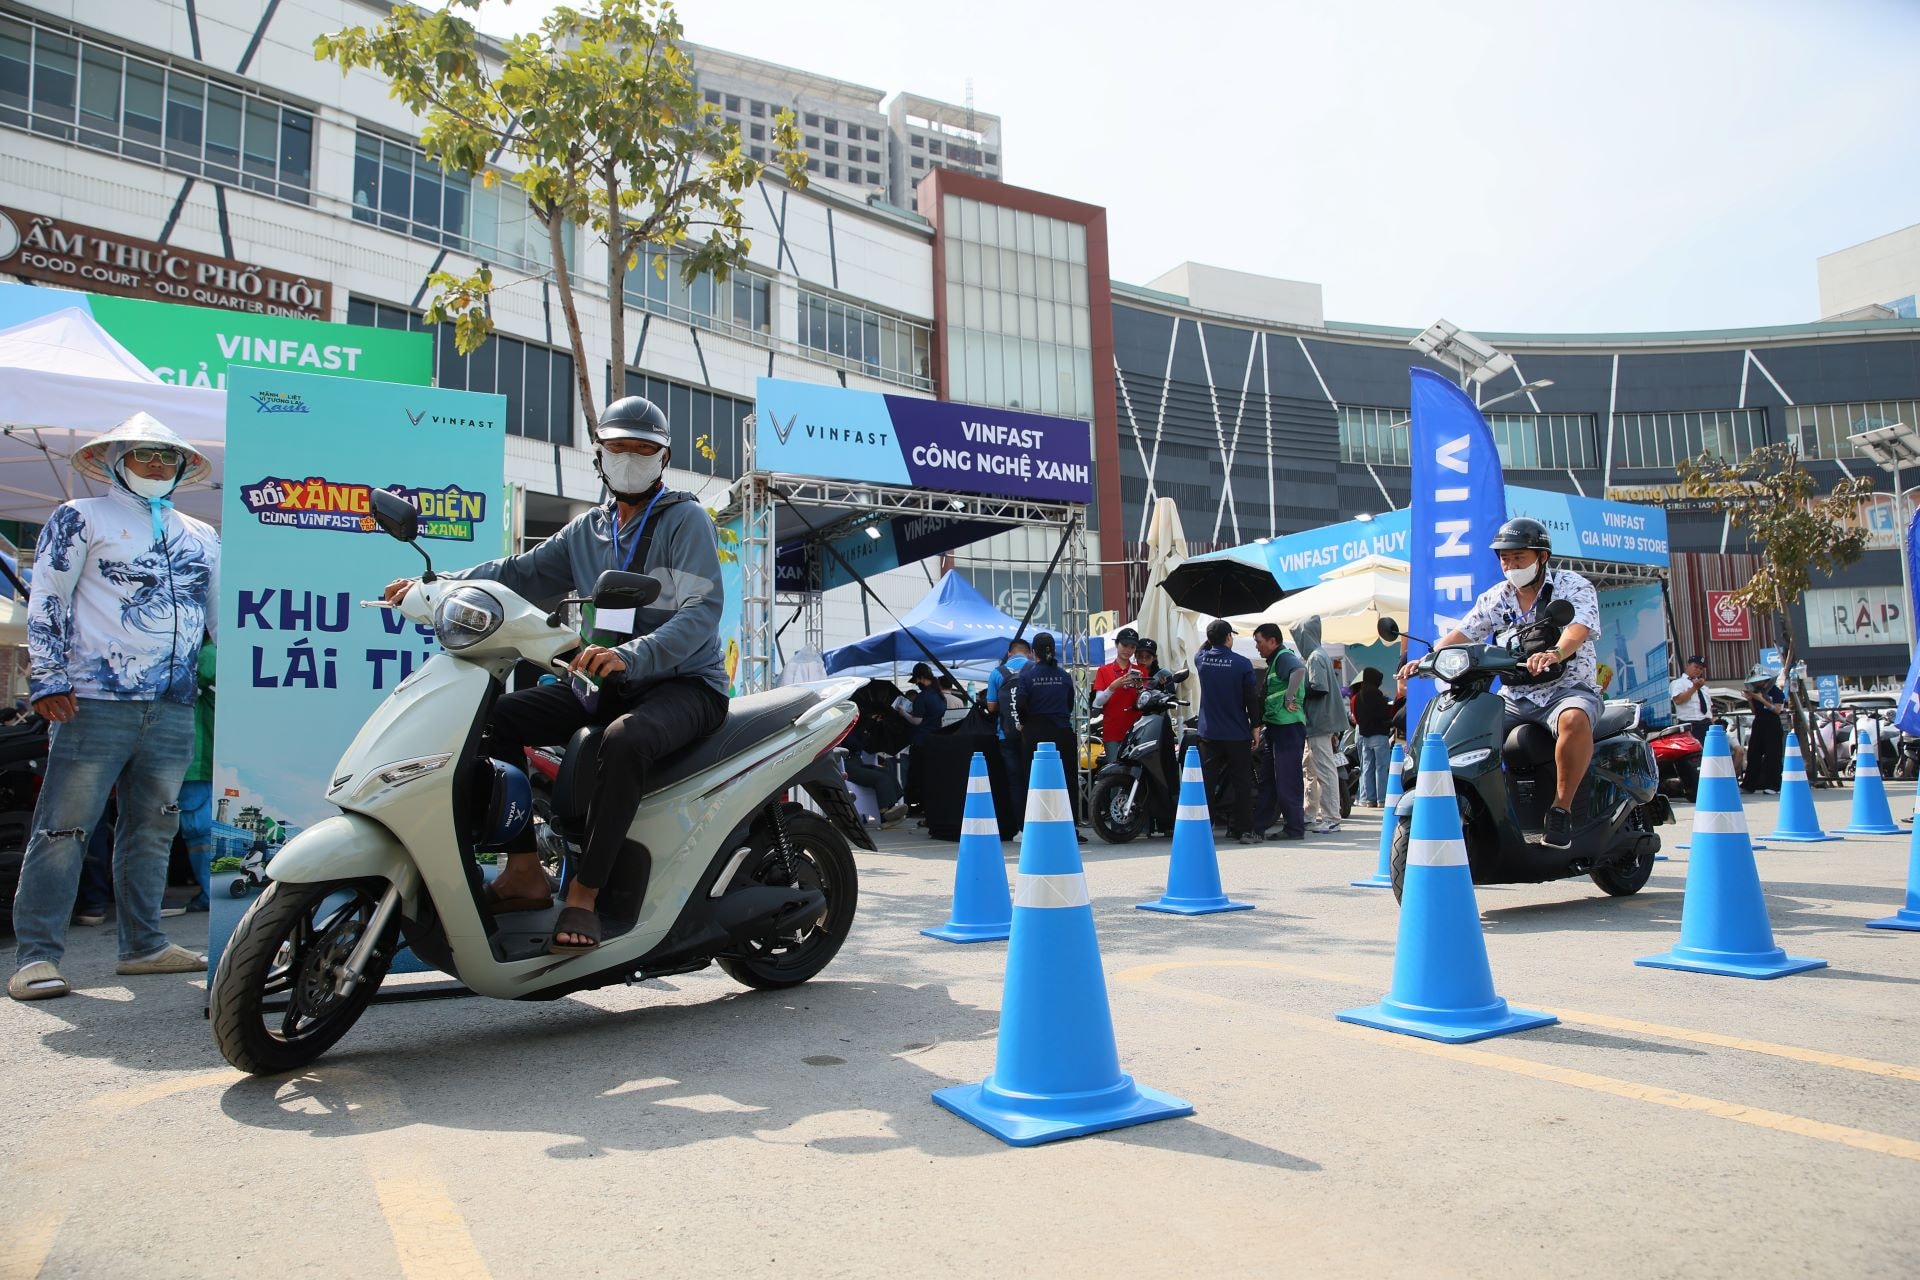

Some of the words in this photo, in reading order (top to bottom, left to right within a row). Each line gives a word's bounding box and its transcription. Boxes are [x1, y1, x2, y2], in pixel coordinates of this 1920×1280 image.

[23, 216, 84, 260] ẨM
[91, 238, 192, 283] THỰC
[195, 264, 264, 298] PHỐ
[267, 278, 325, 313] HỘI
[21, 252, 77, 277] FOOD
[79, 264, 141, 290] COURT
[154, 280, 191, 300] OLD
[191, 286, 266, 315] QUARTER
[216, 332, 362, 372] VINFAST
[432, 416, 494, 429] VINFAST
[806, 425, 888, 446] VINFAST
[961, 421, 1044, 450] VINFAST
[912, 443, 971, 472] CÔNG
[977, 455, 1031, 483] NGHỆ
[1036, 461, 1089, 484] XANH
[281, 480, 371, 513] XĂNG
[261, 511, 297, 525] CÙNG
[428, 523, 467, 537] XANH
[1602, 512, 1645, 531] VINFAST
[1280, 544, 1340, 573] VINFAST
[1342, 540, 1371, 561] GIA
[1373, 530, 1407, 554] HUY
[1581, 530, 1600, 546] GIA
[1602, 534, 1622, 548] HUY
[1624, 536, 1635, 550] 39
[1637, 538, 1667, 554] STORE
[237, 588, 350, 633] KHU
[1600, 599, 1633, 609] INFAST
[1833, 597, 1900, 638] RẬP
